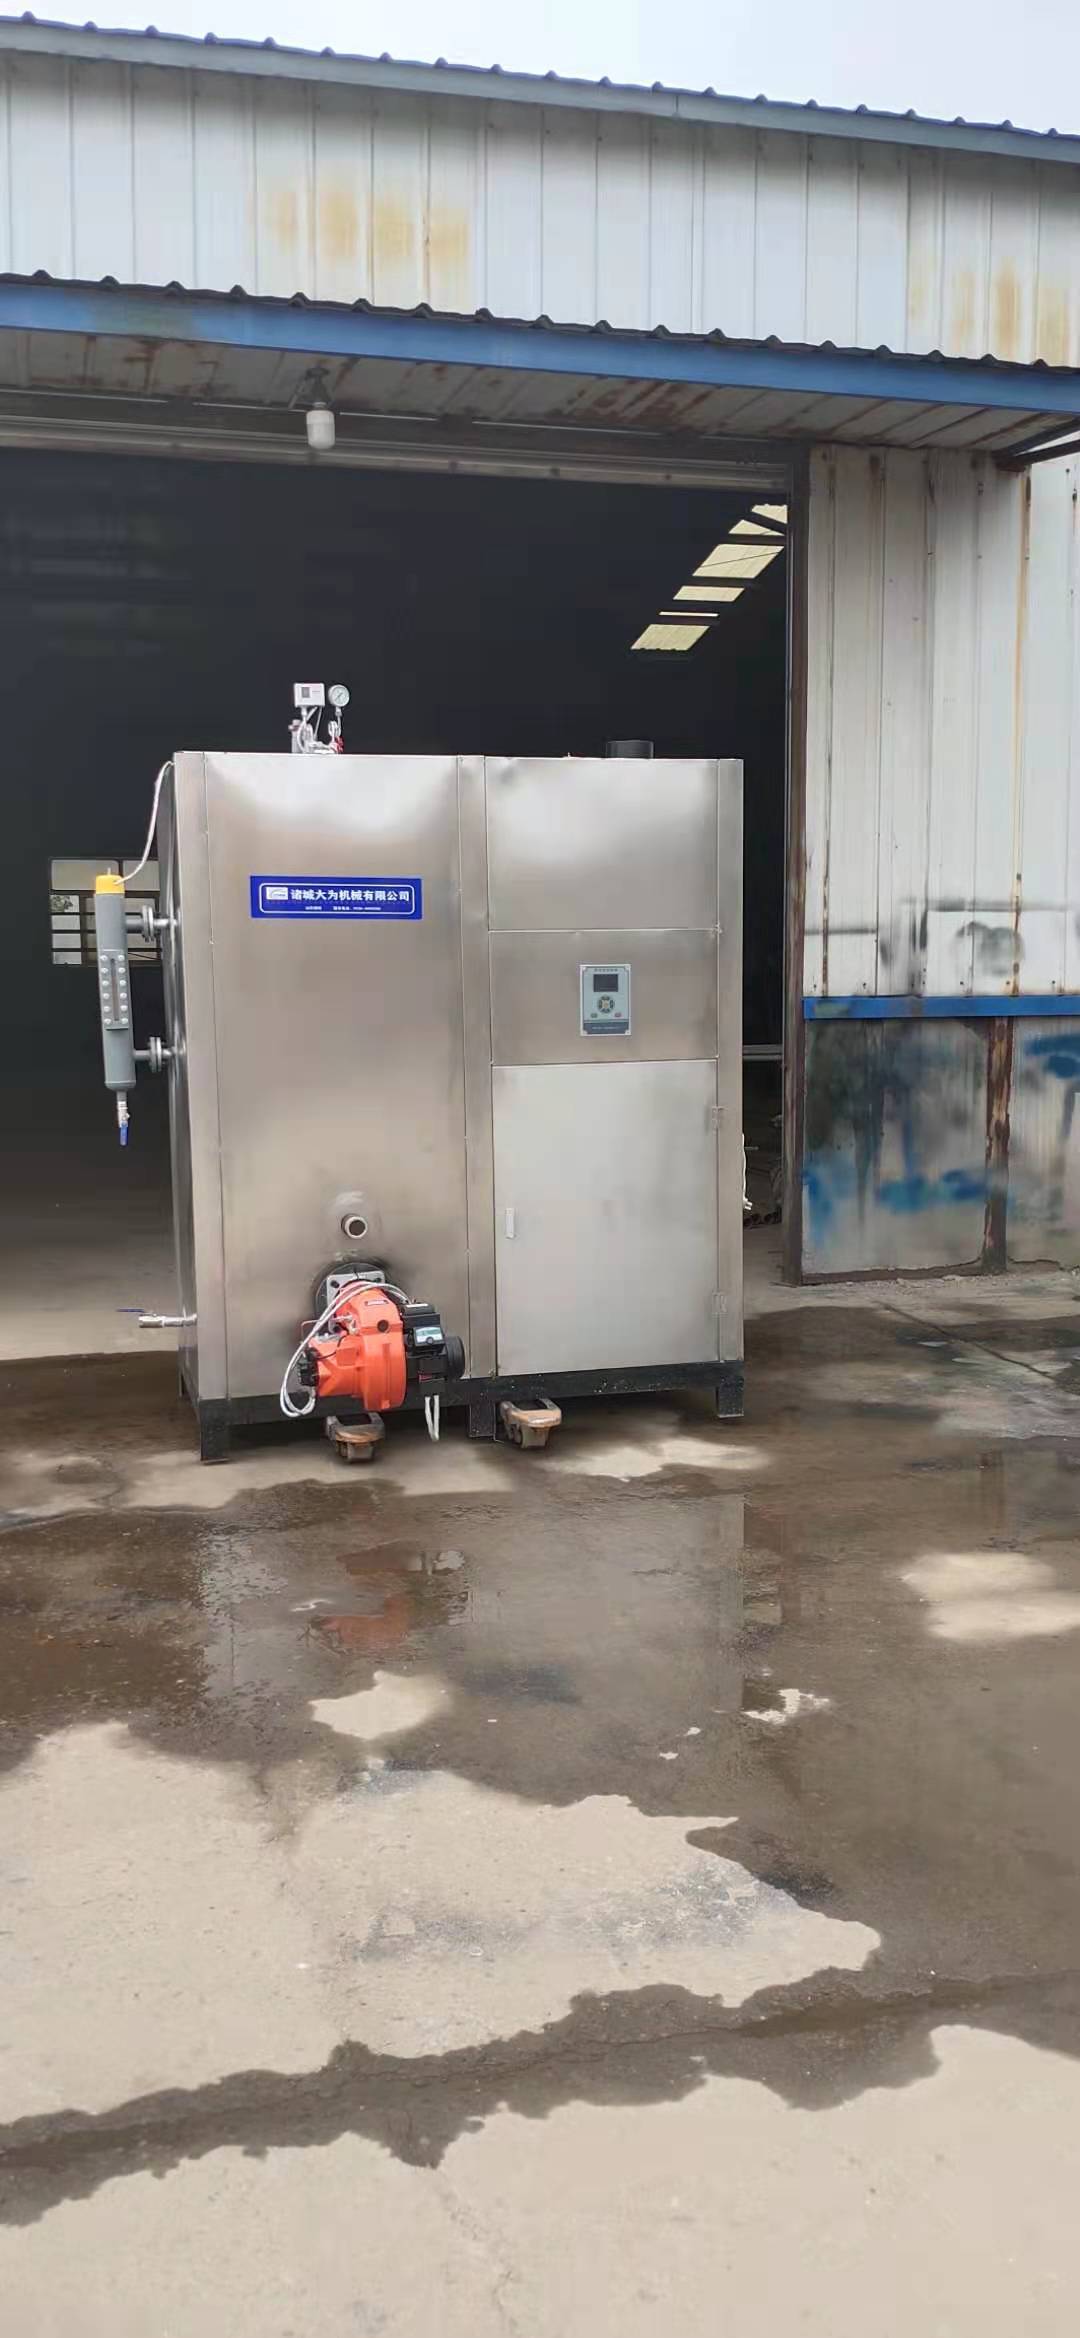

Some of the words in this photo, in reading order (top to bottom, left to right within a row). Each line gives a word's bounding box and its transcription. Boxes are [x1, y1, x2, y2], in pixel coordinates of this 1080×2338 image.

[290, 889, 410, 902] 诸城大为机械有限公司
